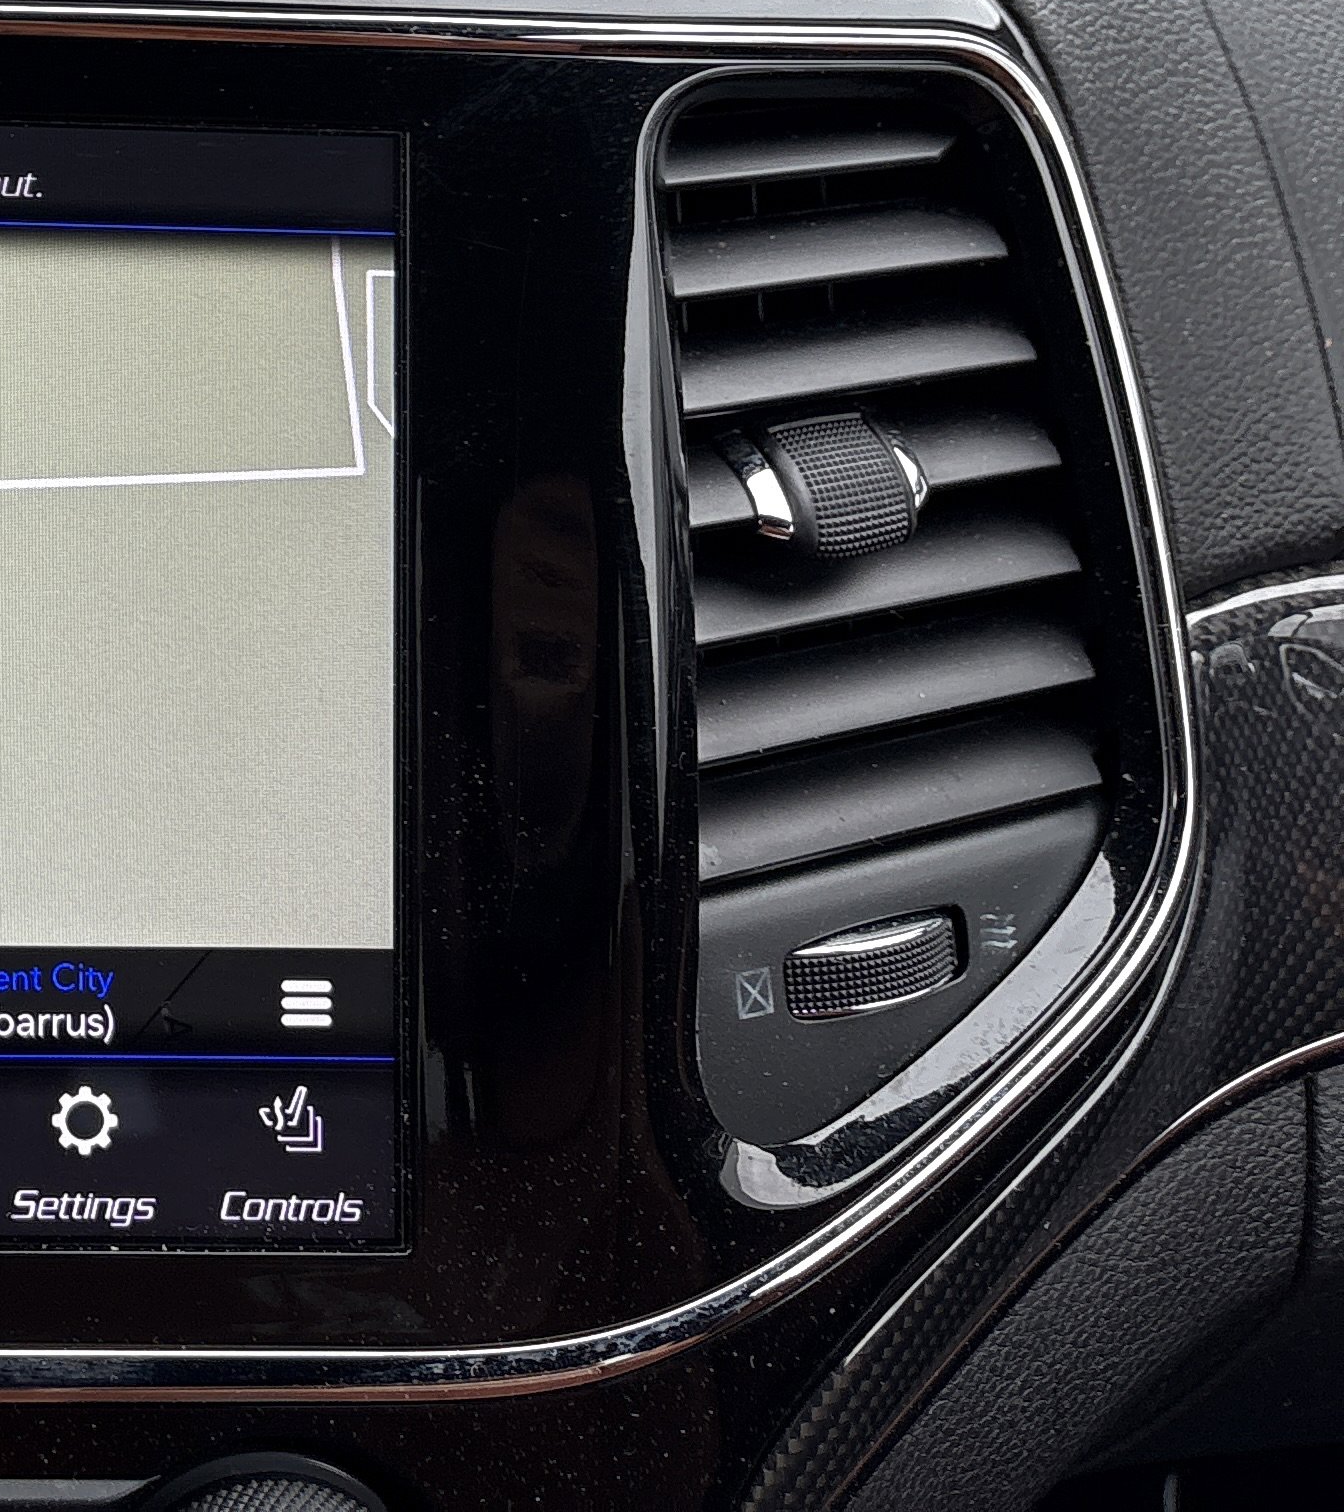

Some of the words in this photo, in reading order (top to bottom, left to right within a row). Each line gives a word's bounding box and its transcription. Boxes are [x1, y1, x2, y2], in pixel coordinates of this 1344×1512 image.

[51, 962, 114, 999] City
[10, 1189, 157, 1228] Settings
[220, 1191, 364, 1224] Controls
